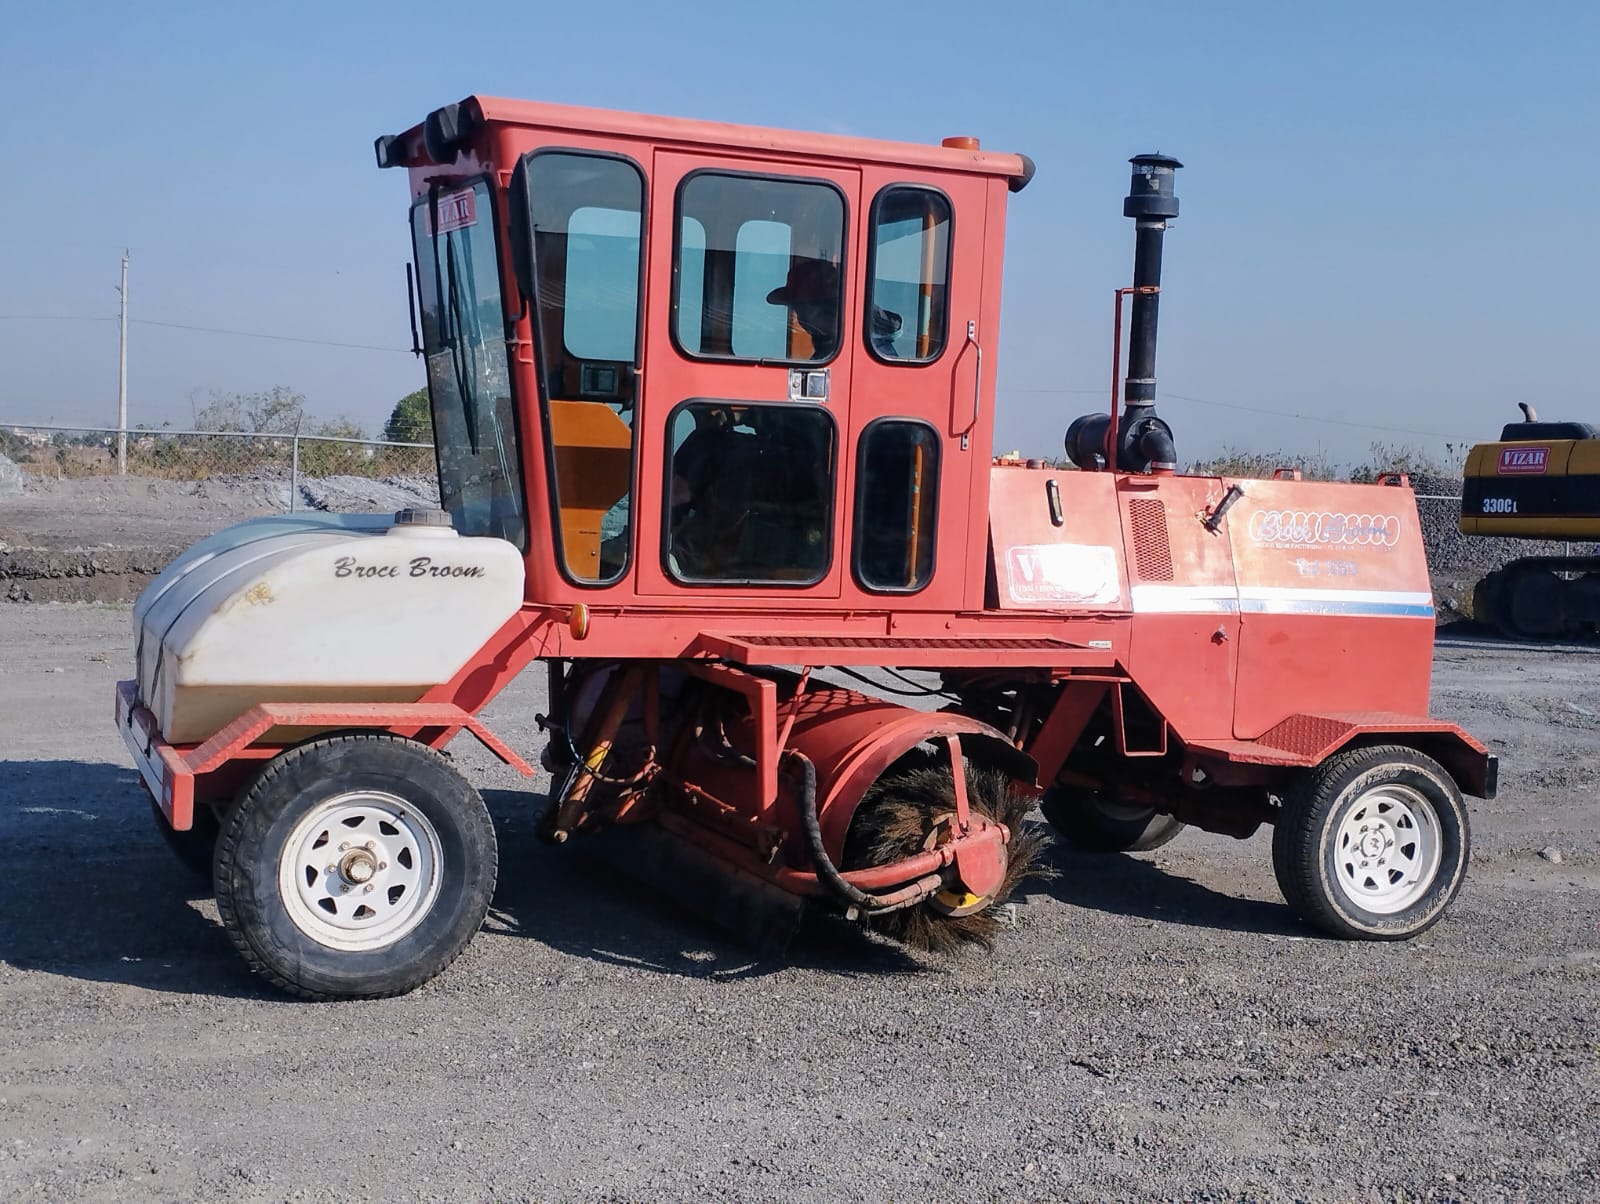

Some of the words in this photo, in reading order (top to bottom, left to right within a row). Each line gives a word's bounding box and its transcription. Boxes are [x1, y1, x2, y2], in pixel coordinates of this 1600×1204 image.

[1503, 451, 1545, 465] VIZAR
[334, 556, 399, 579] Broce
[409, 556, 486, 578] Broom
